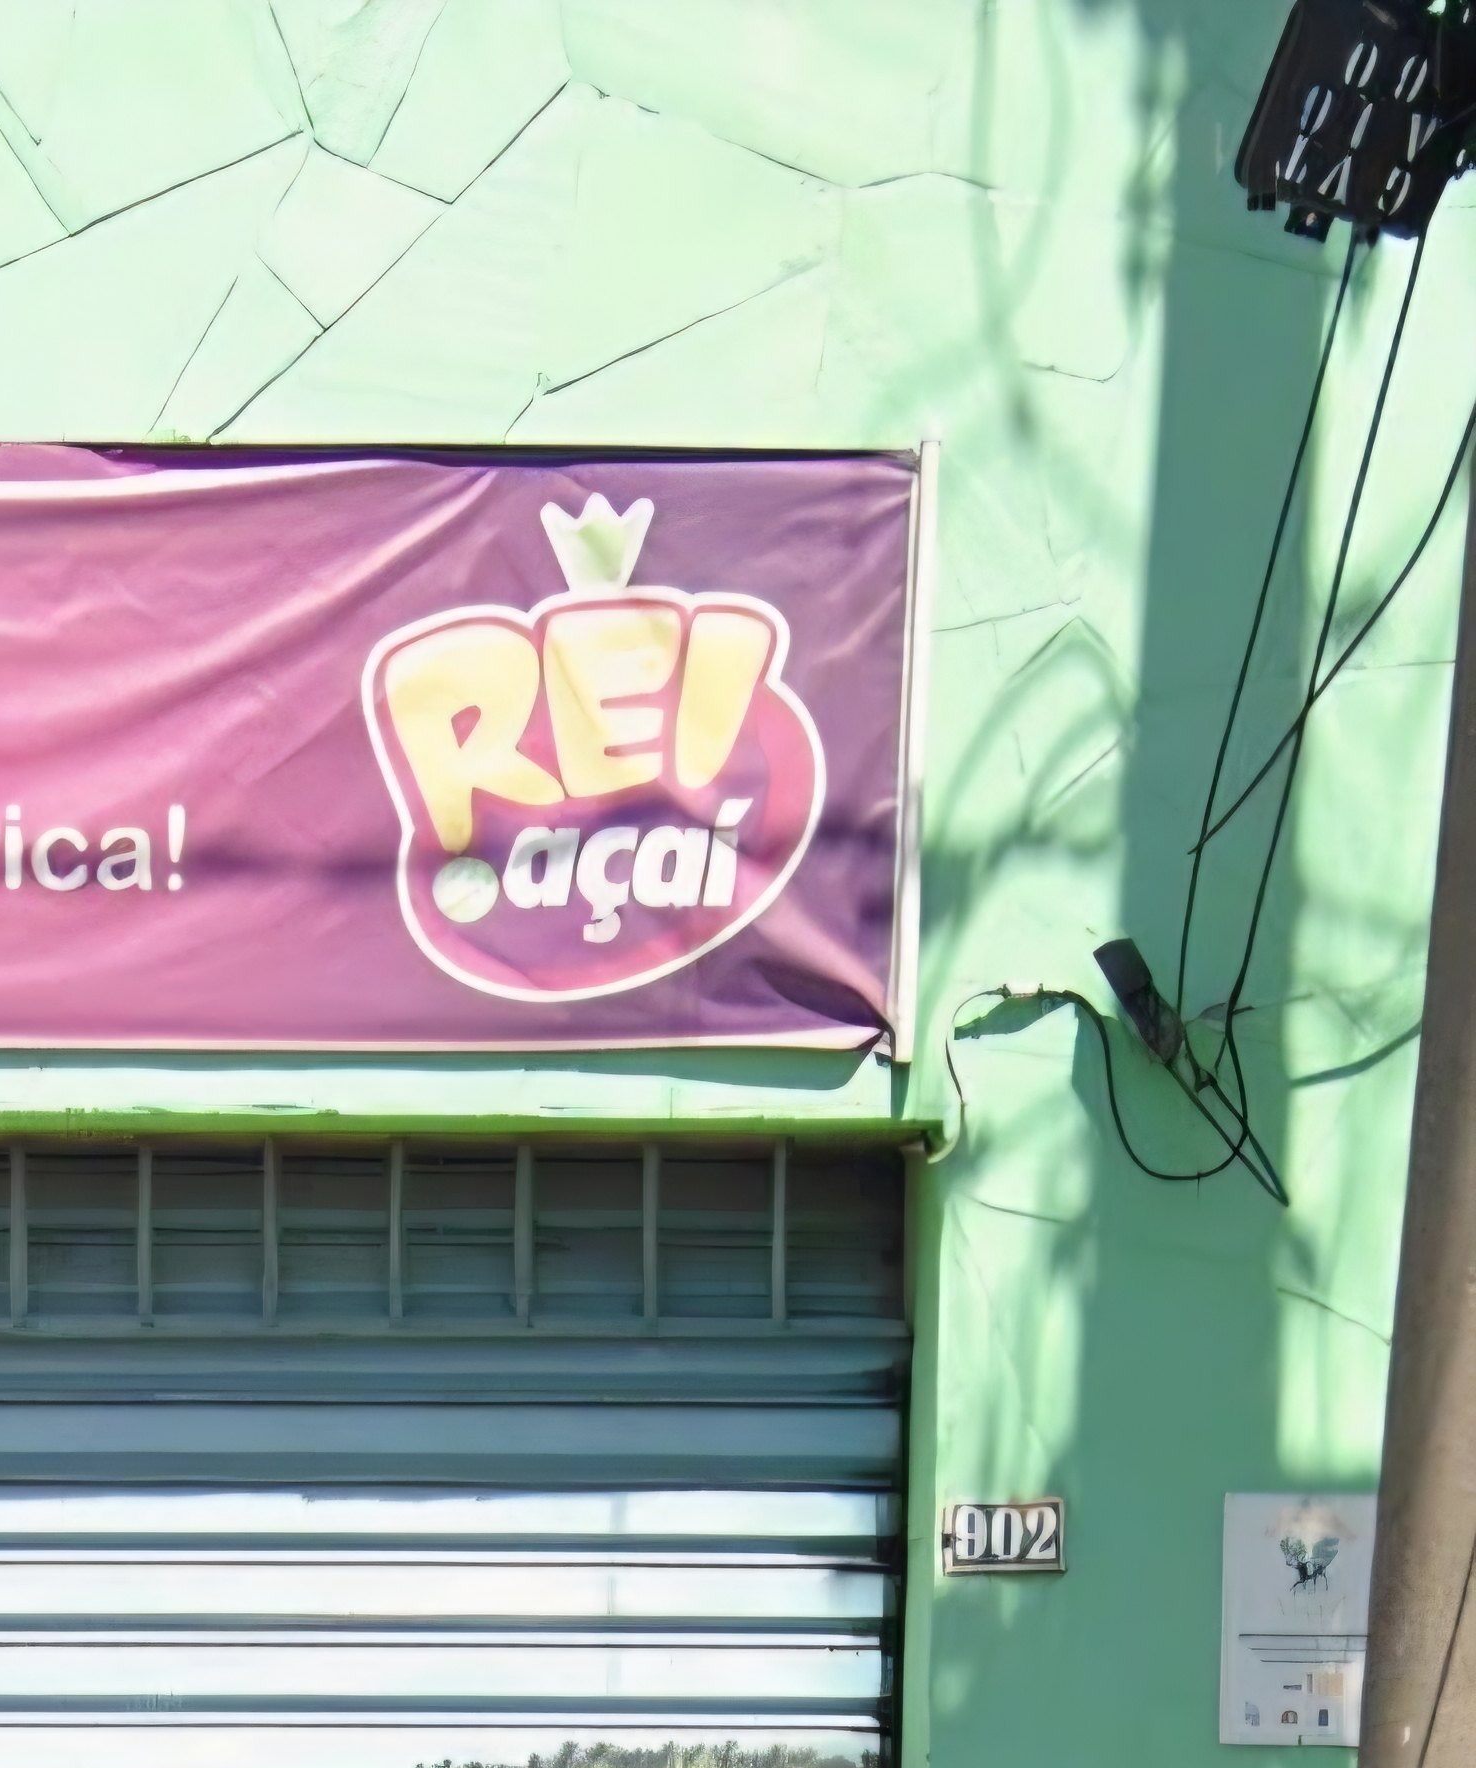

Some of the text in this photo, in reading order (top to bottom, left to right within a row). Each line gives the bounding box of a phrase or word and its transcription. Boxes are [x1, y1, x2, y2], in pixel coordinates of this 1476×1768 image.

[385, 607, 772, 853] REI
[503, 798, 753, 943] açaí
[955, 1505, 1057, 1560] 902
